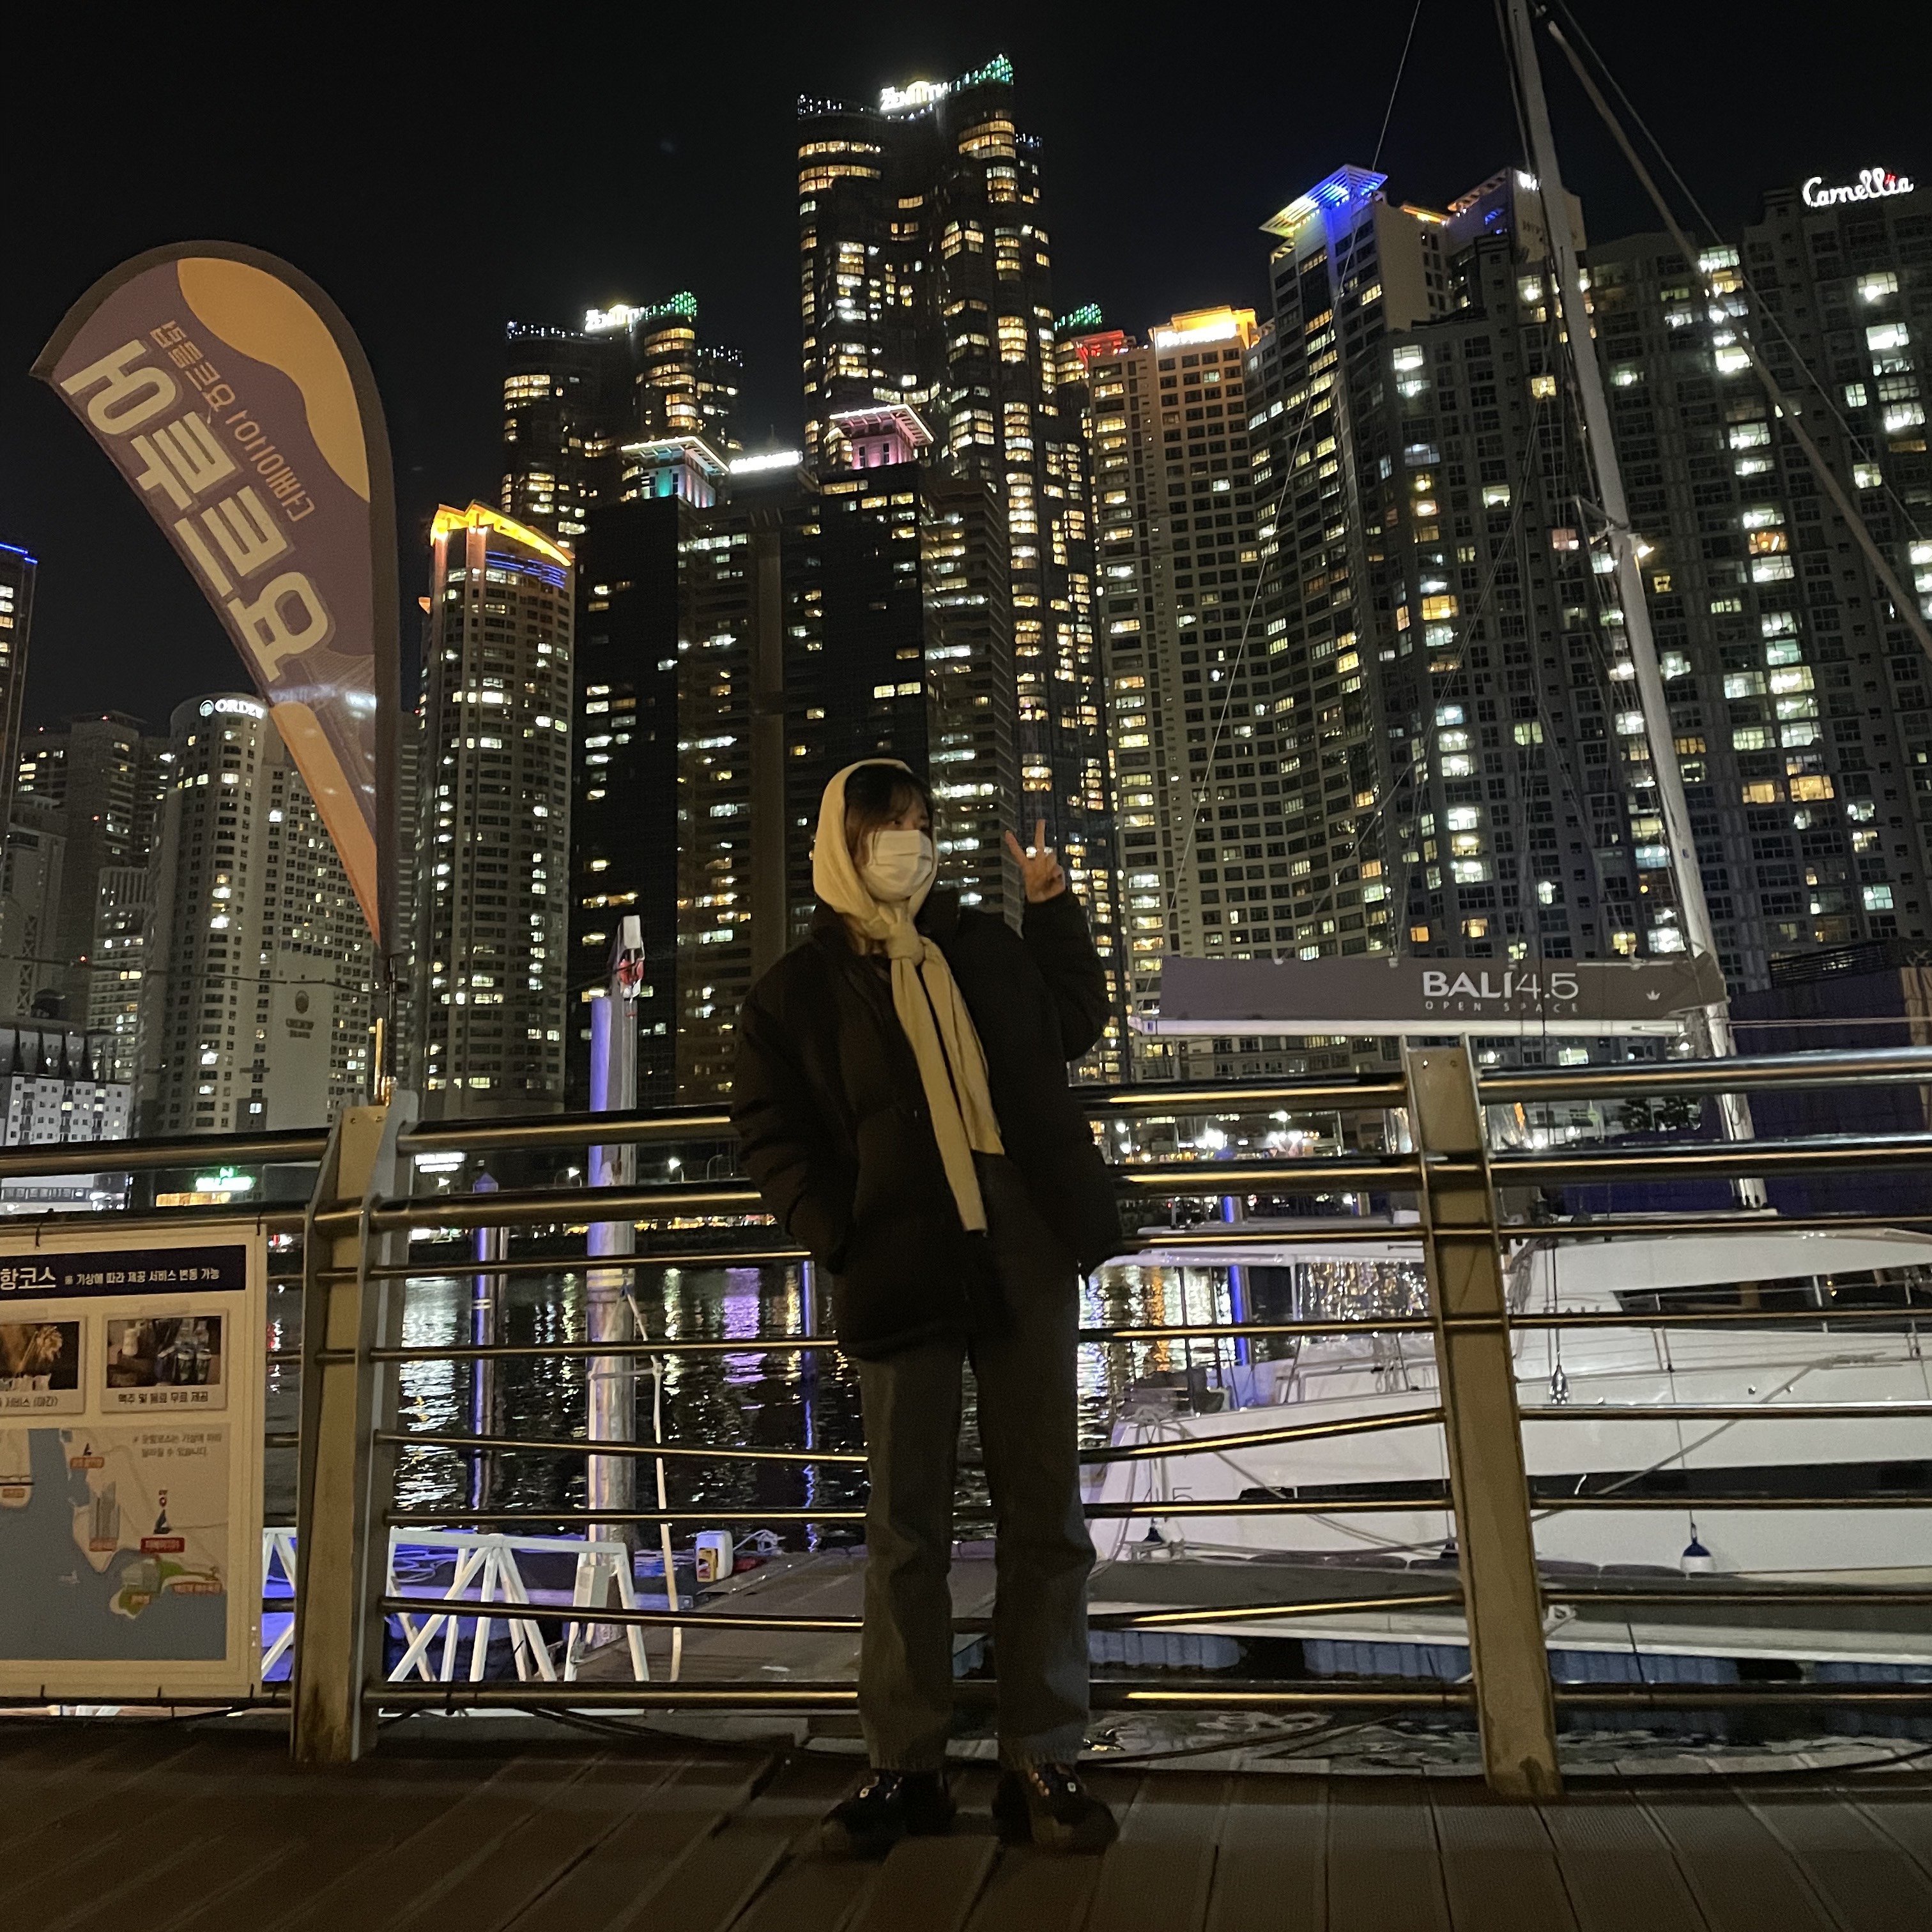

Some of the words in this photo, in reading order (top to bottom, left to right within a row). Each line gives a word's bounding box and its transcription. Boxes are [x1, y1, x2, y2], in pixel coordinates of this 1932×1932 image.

[1802, 167, 1914, 208] Camellia
[1425, 1001, 1481, 1011] OPEN
[1504, 1001, 1579, 1013] SPACE
[149, 1269, 176, 1282] 서비스
